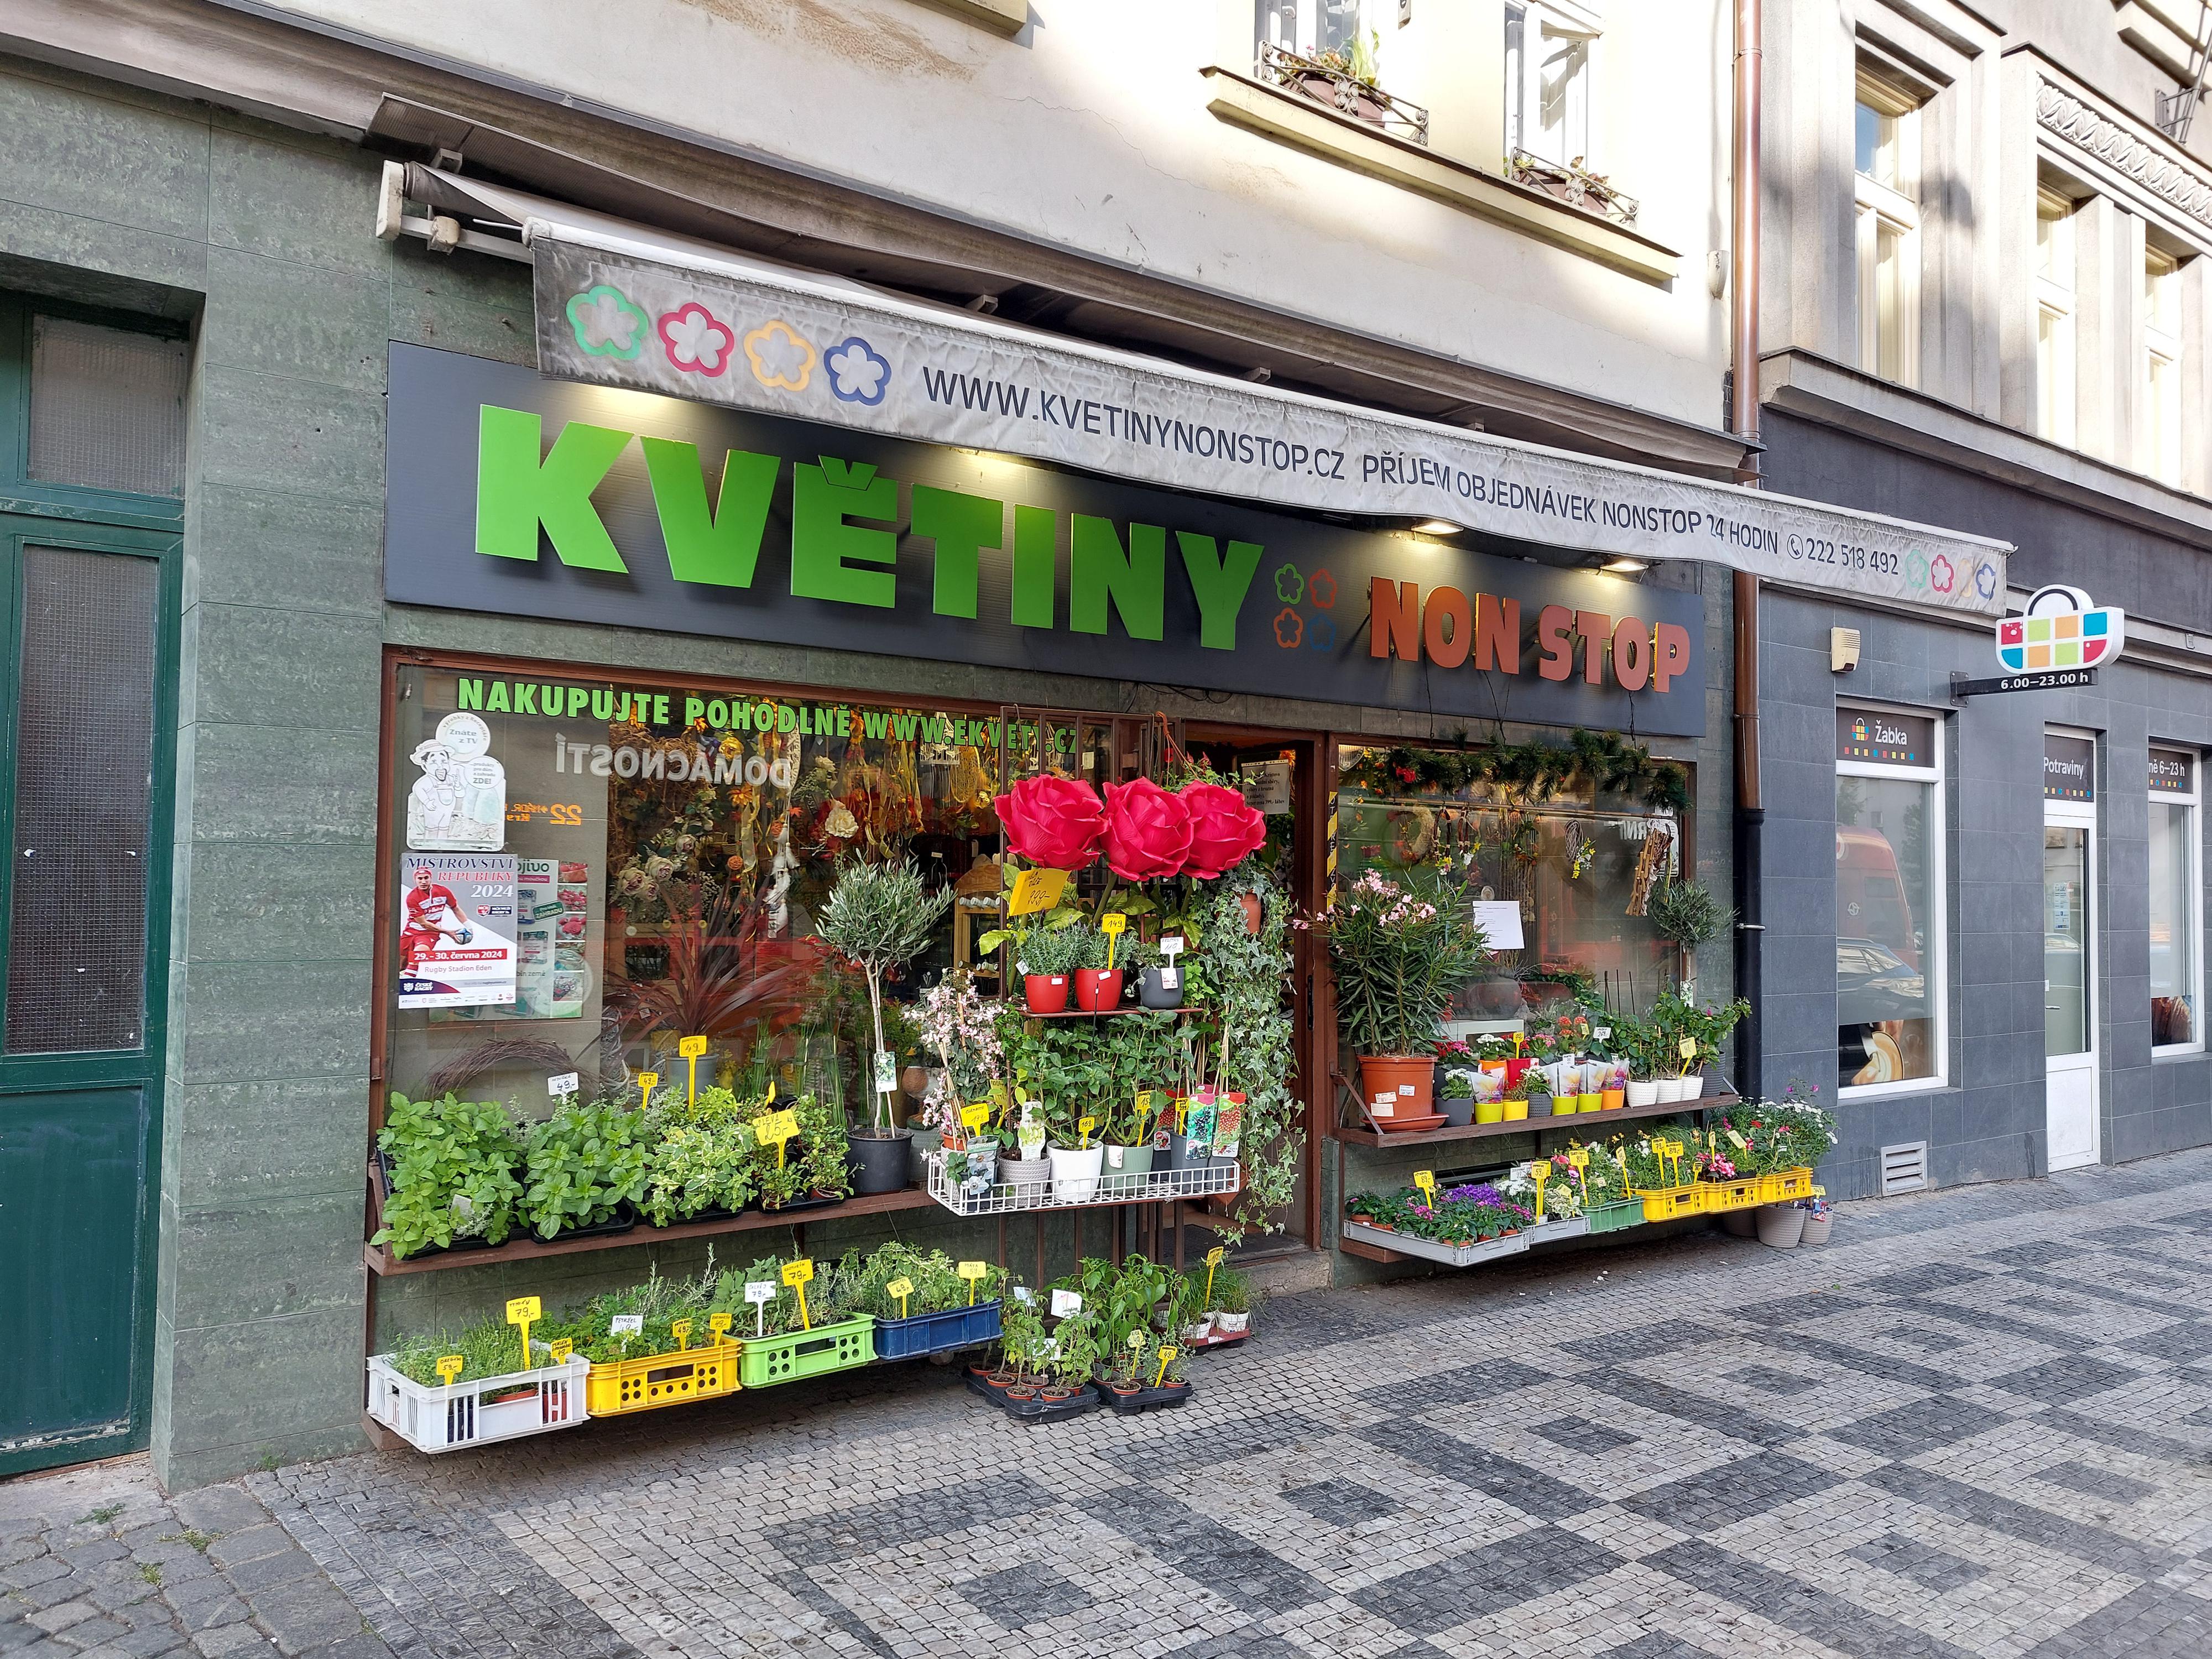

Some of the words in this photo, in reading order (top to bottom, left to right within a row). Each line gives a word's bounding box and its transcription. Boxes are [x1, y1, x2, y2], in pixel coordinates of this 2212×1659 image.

[922, 366, 1345, 481] WWW.KVETINYNONSTOP.CZ
[1363, 450, 1451, 493] PŘÍJEM
[1457, 471, 1597, 524] OBJEDNÁVEK
[1603, 500, 1702, 534] NONSTOP
[1706, 514, 1725, 541] 24
[1729, 523, 1778, 555] HODIN
[1806, 538, 1835, 564] 222
[1841, 544, 1865, 570] 518
[1870, 550, 1898, 576] 492
[476, 404, 1265, 651] KVĚTINY
[1369, 576, 1521, 675] NON
[1538, 603, 1691, 692] STOP
[2079, 672, 2088, 683] h
[457, 677, 670, 725] NAKUPUJTE
[685, 697, 852, 738] POHODLNĚ
[1875, 719, 1907, 745] Žabka
[2043, 757, 2084, 776] Potraviny
[2180, 765, 2185, 776] h
[406, 856, 513, 869] MISTROVSTVÍ
[438, 872, 513, 881] REPUBLIKY
[471, 884, 514, 898] 2024
[757, 1114, 779, 1128] SLEVA
